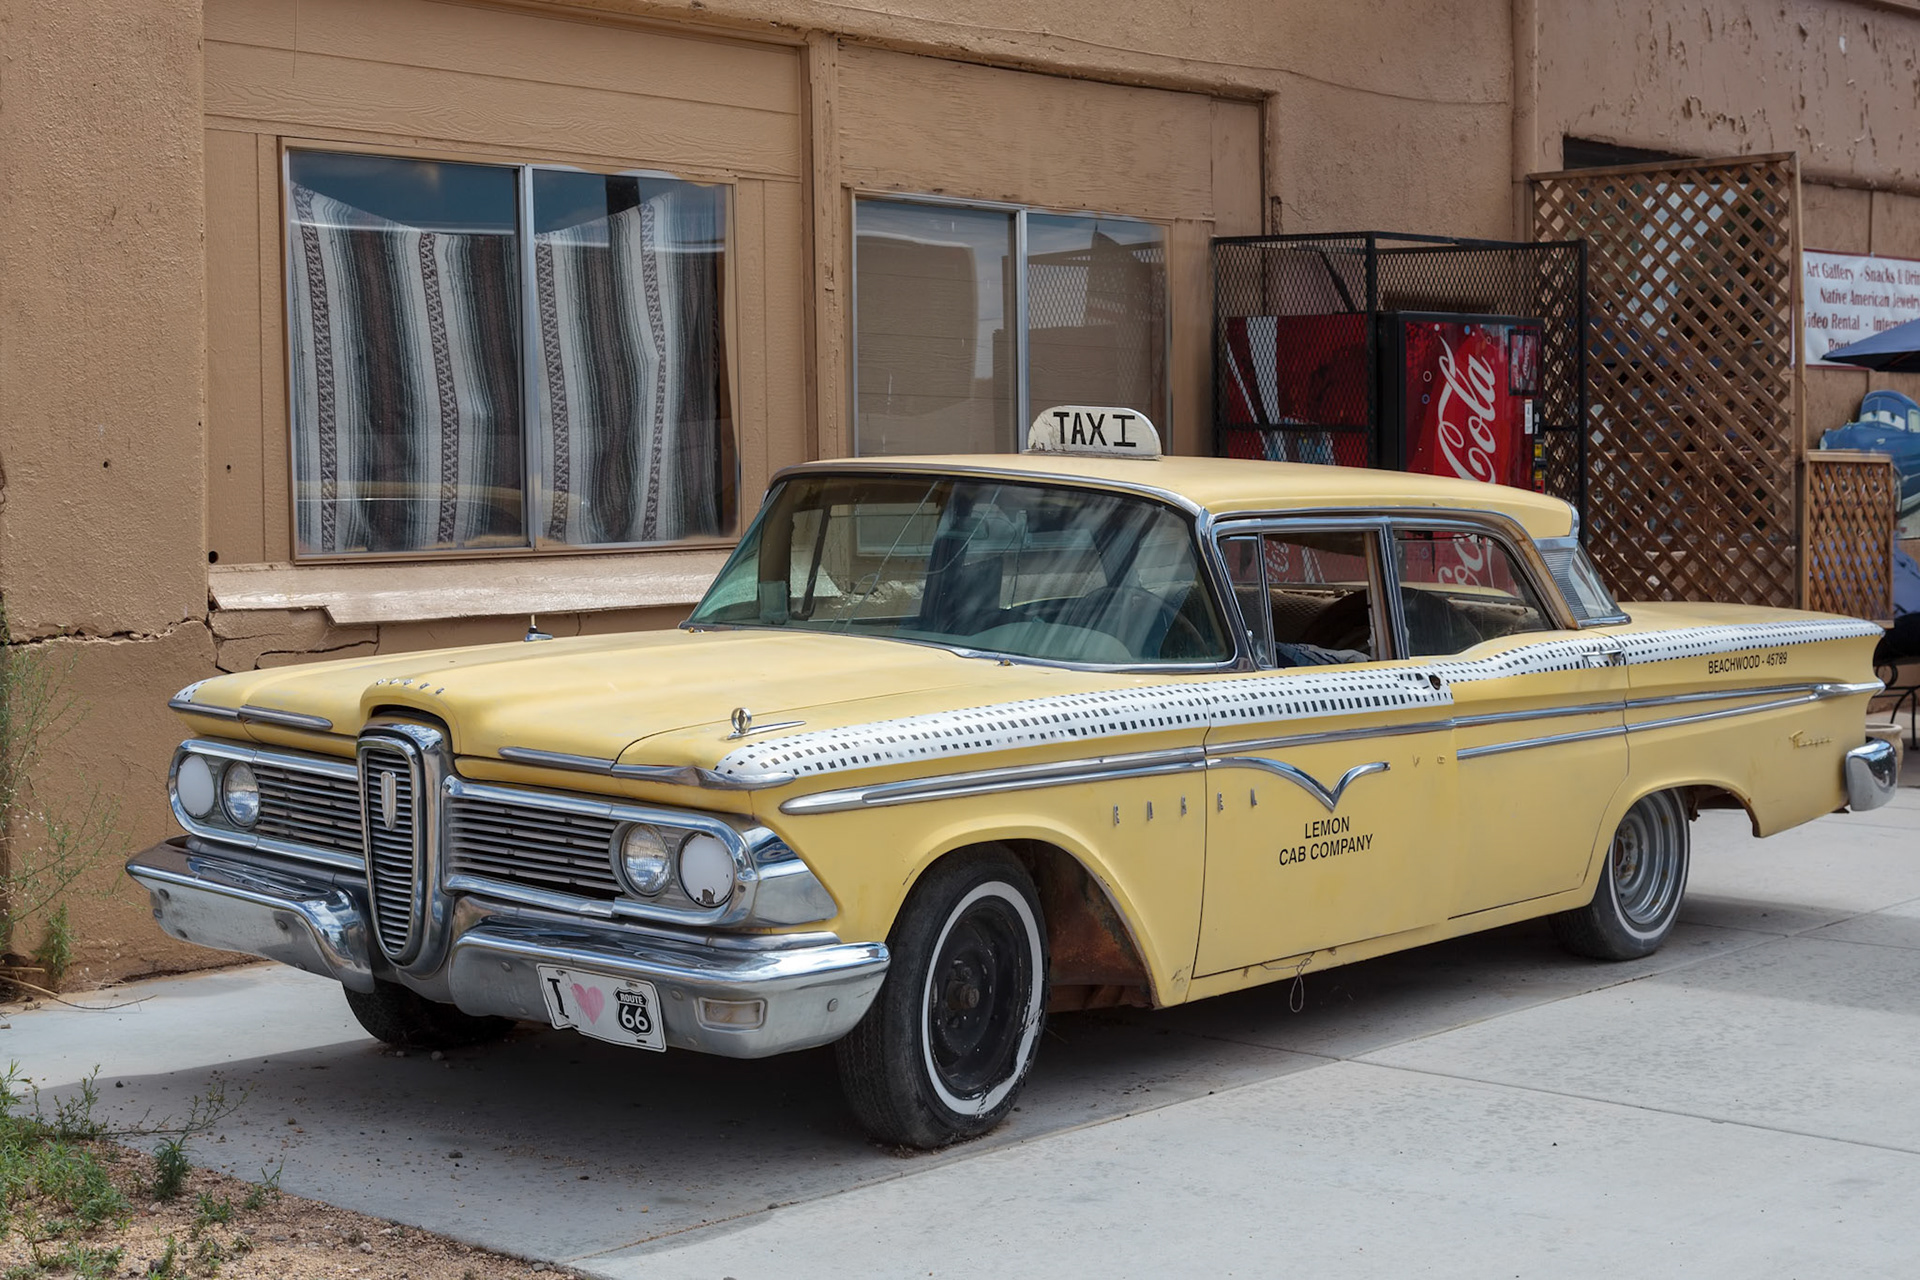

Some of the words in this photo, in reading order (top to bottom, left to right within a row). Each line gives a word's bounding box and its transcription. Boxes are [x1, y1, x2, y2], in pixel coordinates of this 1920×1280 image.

[1806, 261, 1820, 278] Art
[1822, 262, 1854, 284] Gallery
[1864, 265, 1896, 284] Snacks
[1820, 287, 1847, 305] Native
[1850, 290, 1890, 308] American
[1804, 312, 1829, 330] ideo
[1831, 313, 1860, 331] Rental
[1053, 412, 1136, 447] TAXI
[1708, 654, 1761, 674] BEACHWOOD
[1766, 652, 1788, 667] 45789
[1305, 816, 1350, 839] LEMON
[1279, 842, 1306, 866] CAB
[1310, 834, 1374, 861] COMPANY
[547, 977, 569, 1019] I
[620, 992, 643, 1005] ROUTE
[621, 1004, 649, 1031] 66
